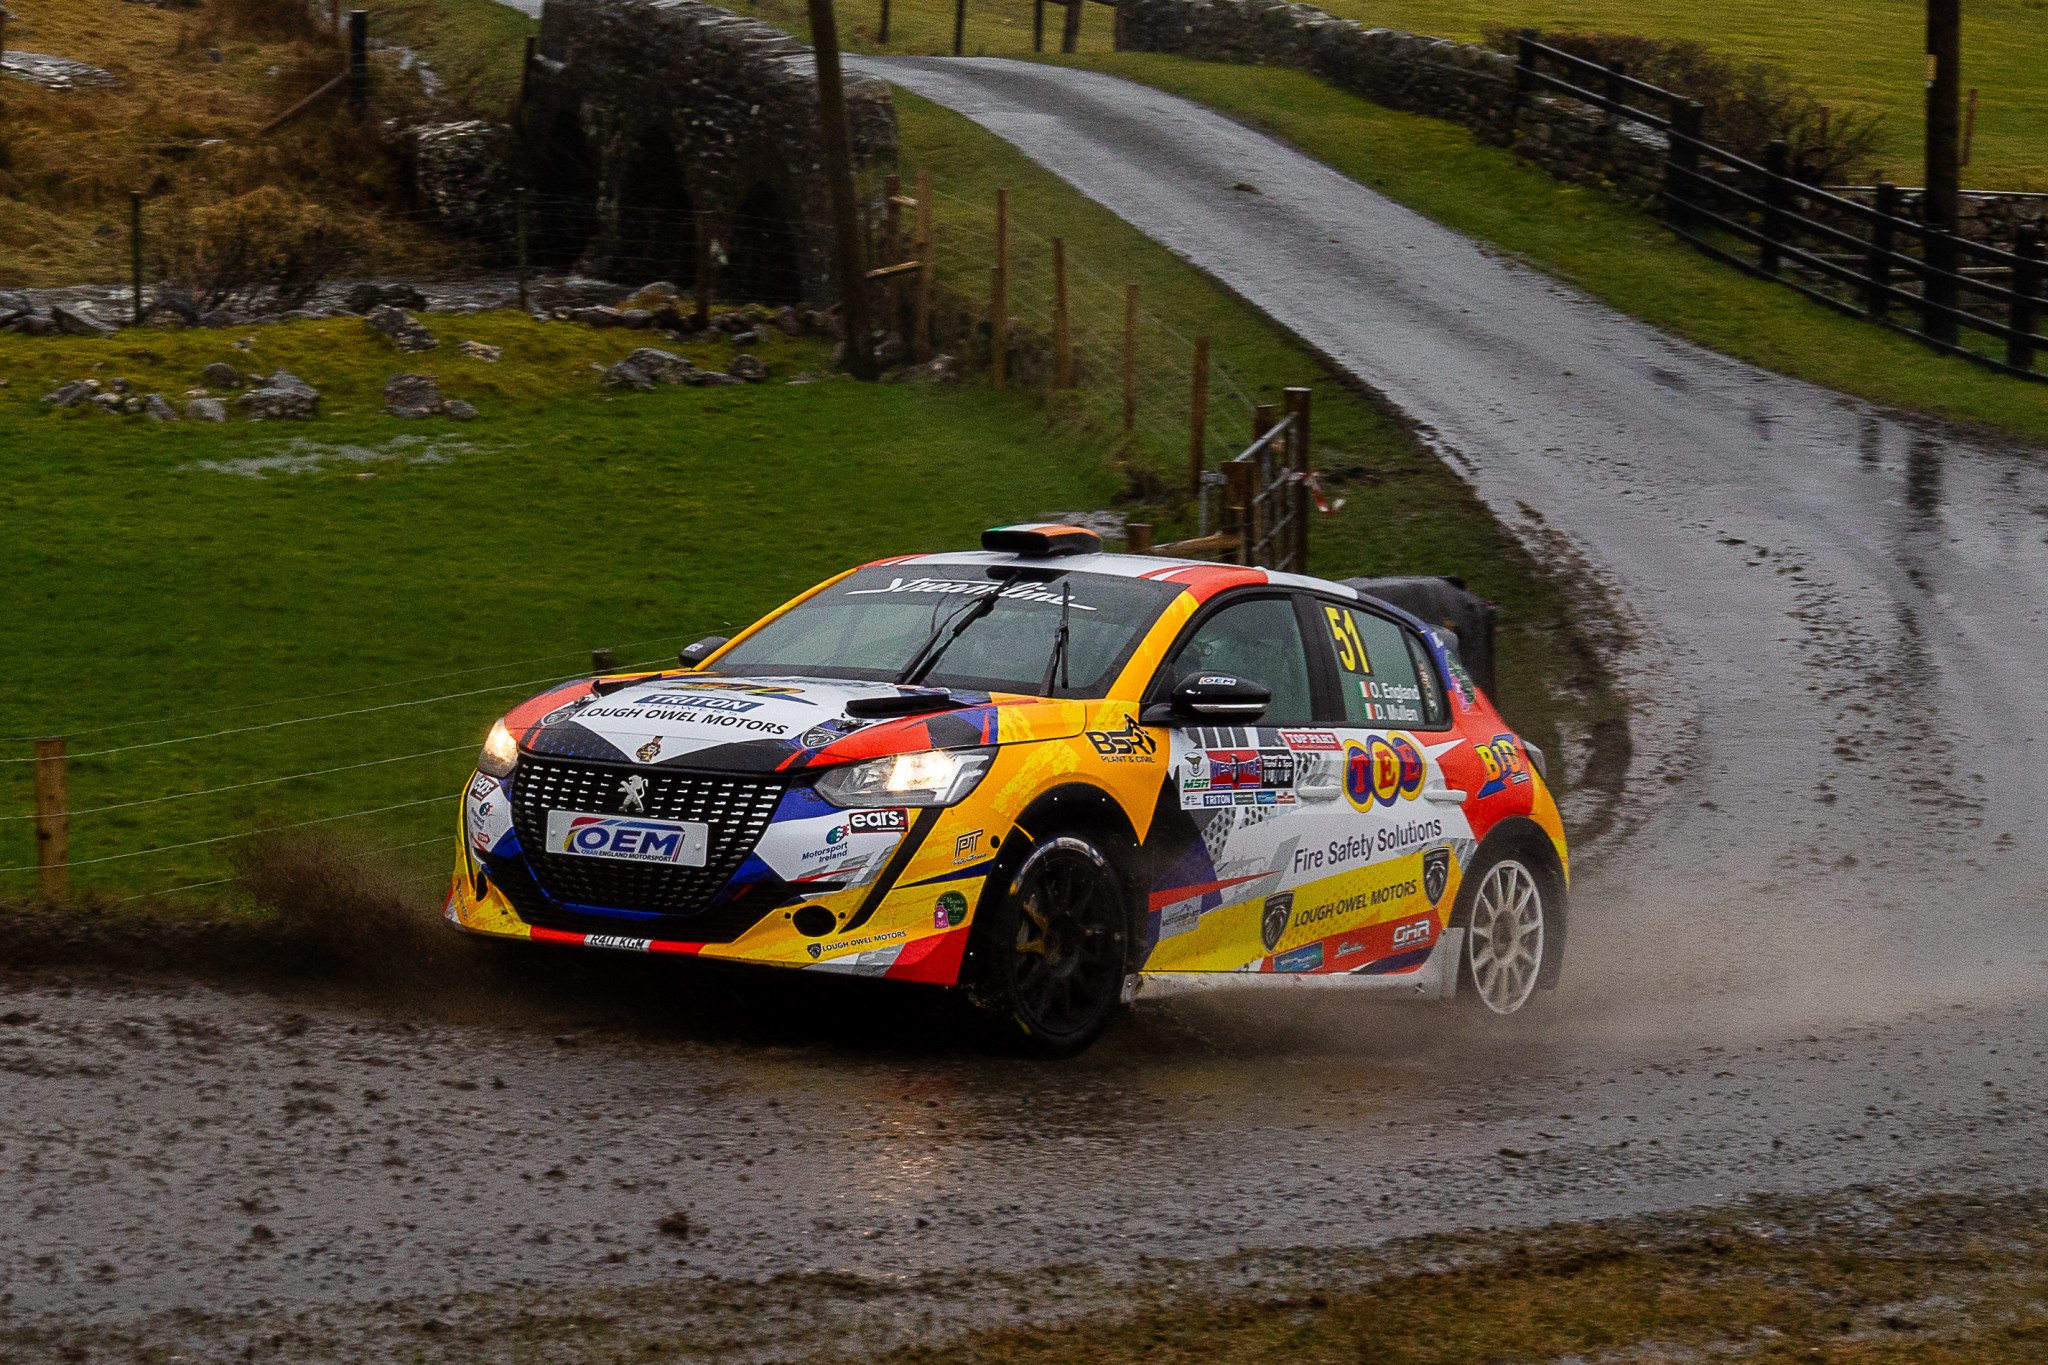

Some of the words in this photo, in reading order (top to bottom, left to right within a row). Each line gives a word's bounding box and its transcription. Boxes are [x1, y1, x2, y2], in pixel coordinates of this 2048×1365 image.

[1324, 607, 1370, 674] 51
[647, 695, 748, 710] TRITON
[1369, 682, 1382, 698] O.
[1382, 683, 1421, 703] England
[578, 708, 644, 719] LOUGH
[645, 709, 697, 722] OWEL
[701, 714, 790, 735] MOTORS
[1374, 704, 1386, 720] D.
[1204, 795, 1231, 804] TRITON
[576, 826, 680, 856] OEM
[802, 842, 848, 860] Motorsport
[1294, 846, 1323, 874] Fire
[1328, 833, 1375, 865] Safety
[1377, 818, 1442, 851] Solutions
[599, 851, 628, 859] ENGLAND
[628, 853, 672, 862] MOTORSPORT
[819, 850, 848, 863] Ireland
[1294, 904, 1334, 927] LOUGH
[1336, 893, 1367, 915] OWEL
[1370, 880, 1417, 906] MOTORS
[822, 941, 848, 952] LOUGH
[851, 937, 872, 946] OWEL
[874, 930, 907, 942] MOTORS
